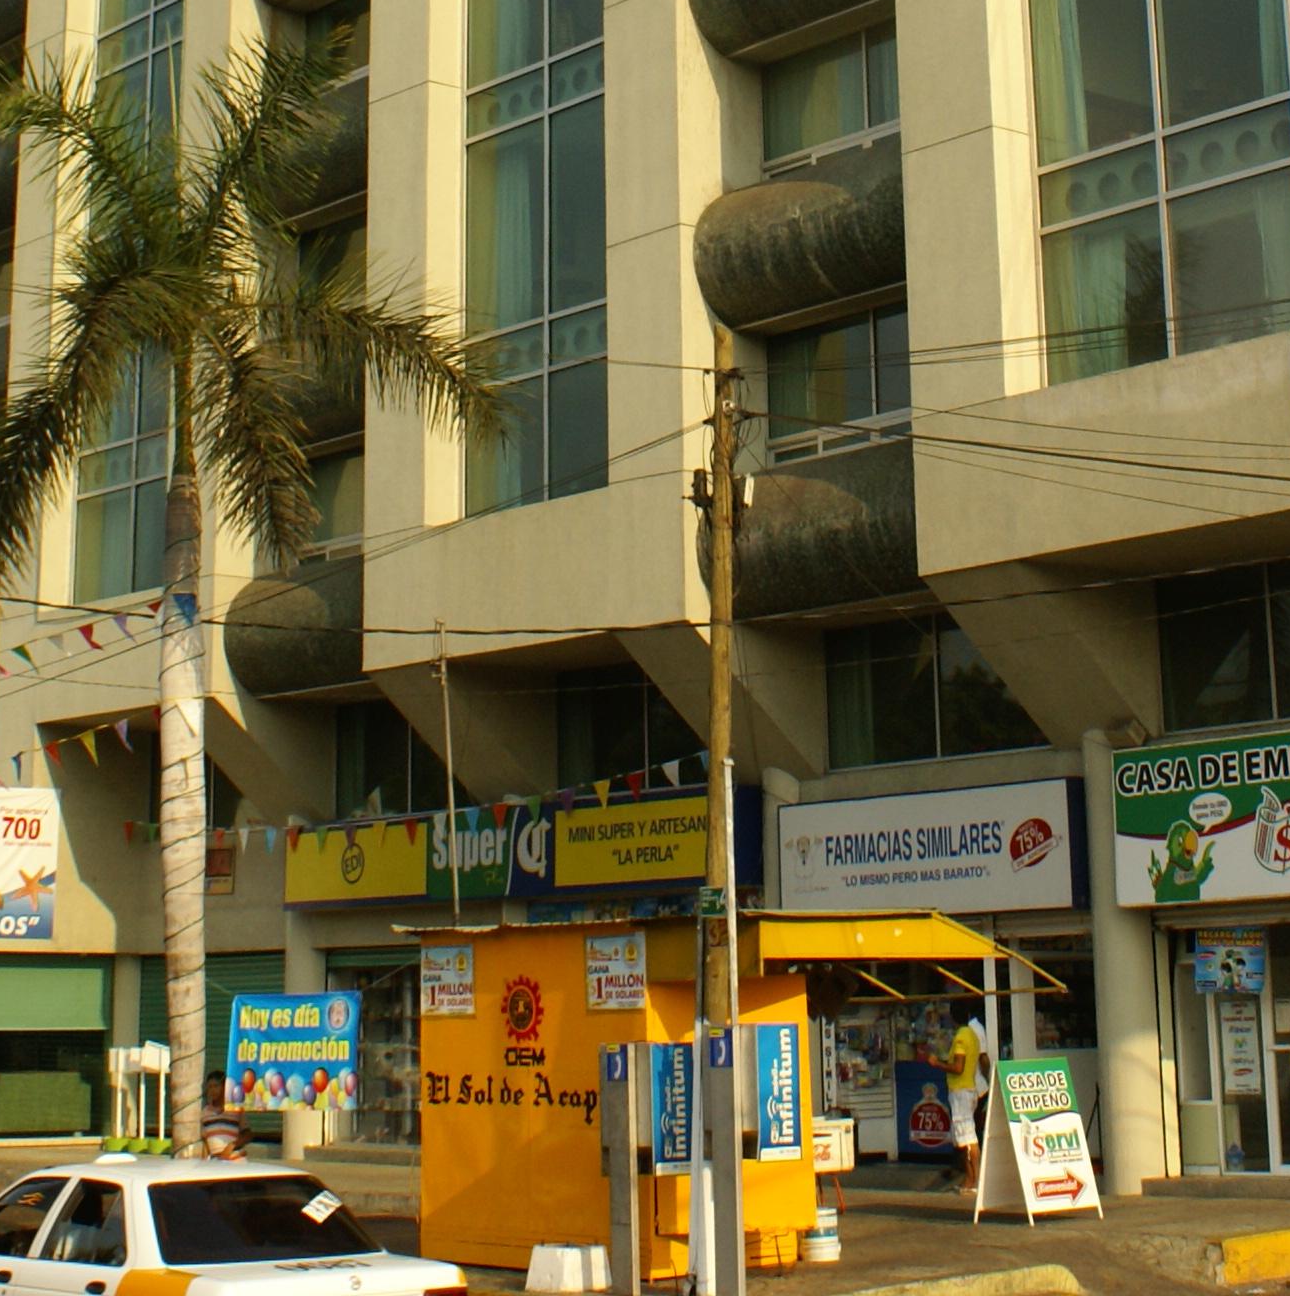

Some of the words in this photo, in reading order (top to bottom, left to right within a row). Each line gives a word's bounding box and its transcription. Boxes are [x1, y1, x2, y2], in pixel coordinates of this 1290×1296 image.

[1116, 757, 1195, 795] CASA
[1198, 752, 1240, 786] DE
[2, 816, 42, 840] 700
[568, 824, 596, 844] MINI
[597, 821, 636, 841] SUPER
[639, 820, 649, 838] Y
[1015, 824, 1045, 854] 75%
[432, 821, 508, 872] Super
[824, 828, 912, 867] FARMACIAS
[916, 820, 1003, 860] SIMILARES
[859, 873, 890, 887] MISMO
[891, 871, 918, 884] PERO
[919, 869, 941, 882] MAS
[239, 1005, 270, 1031] Hoy
[271, 1007, 292, 1029] es
[293, 1003, 321, 1028] día
[237, 1037, 258, 1063] de
[259, 1034, 351, 1065] promoción
[504, 1047, 547, 1067] OEM
[425, 1070, 451, 1105] El
[456, 1073, 494, 1105] Sol
[499, 1076, 525, 1106] de
[777, 1027, 795, 1145] infinitum
[1008, 1073, 1045, 1091] CASA
[1046, 1071, 1066, 1088] DE
[672, 1047, 688, 1159] infinitum
[1011, 1088, 1071, 1112] EMPEÑO
